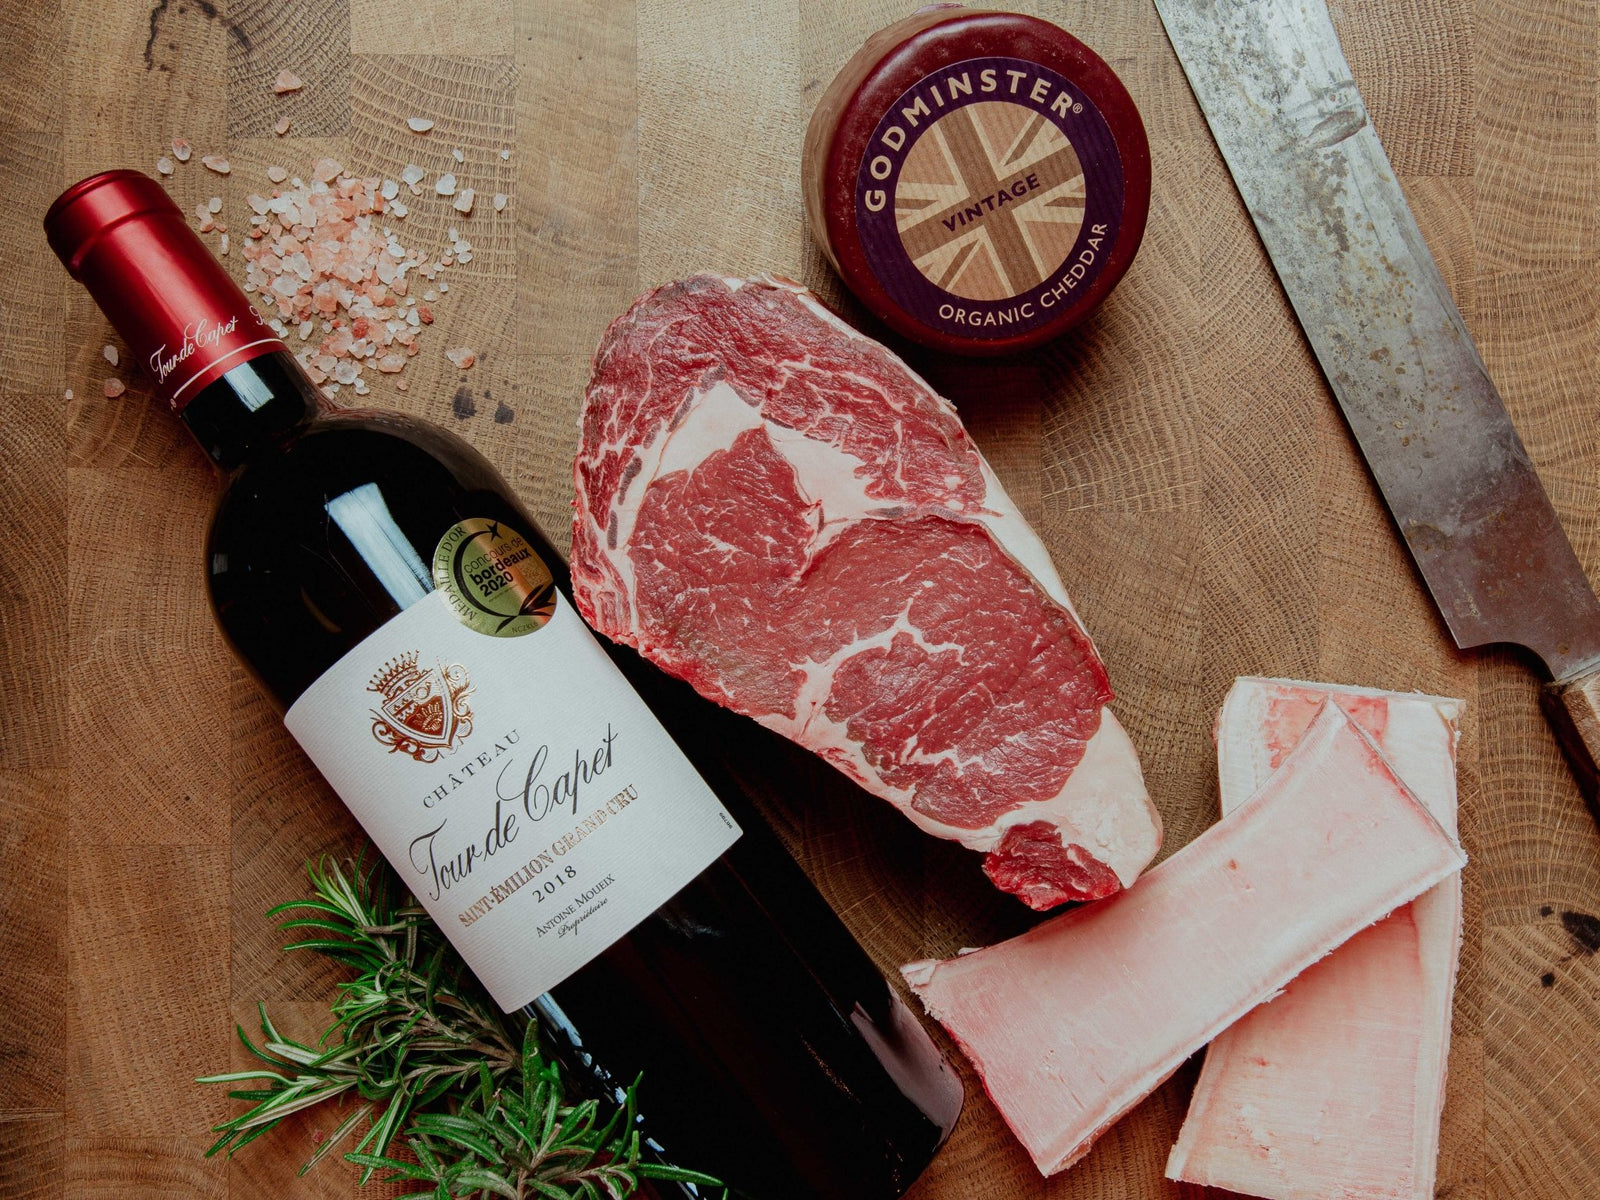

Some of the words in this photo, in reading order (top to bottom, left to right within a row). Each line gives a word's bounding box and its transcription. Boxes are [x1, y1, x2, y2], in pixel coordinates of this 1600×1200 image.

[942, 173, 1040, 233] VINTAGE
[939, 303, 1035, 327] ORGANIC
[1040, 222, 1107, 308] CHEDDAR
[179, 336, 196, 363] de
[184, 315, 239, 347] Capet
[150, 344, 180, 385] Tour
[441, 526, 467, 554] D'OR
[463, 543, 512, 574] concours
[510, 537, 524, 551] de
[469, 547, 532, 586] bordeaux
[480, 570, 514, 598] 2020
[423, 729, 521, 809] CHÂTEAU
[496, 722, 619, 821] Capet
[483, 799, 520, 862] de
[552, 808, 608, 857] GRAND
[606, 783, 639, 821] CRU
[408, 818, 482, 901] Tour
[532, 865, 577, 903] 2018
